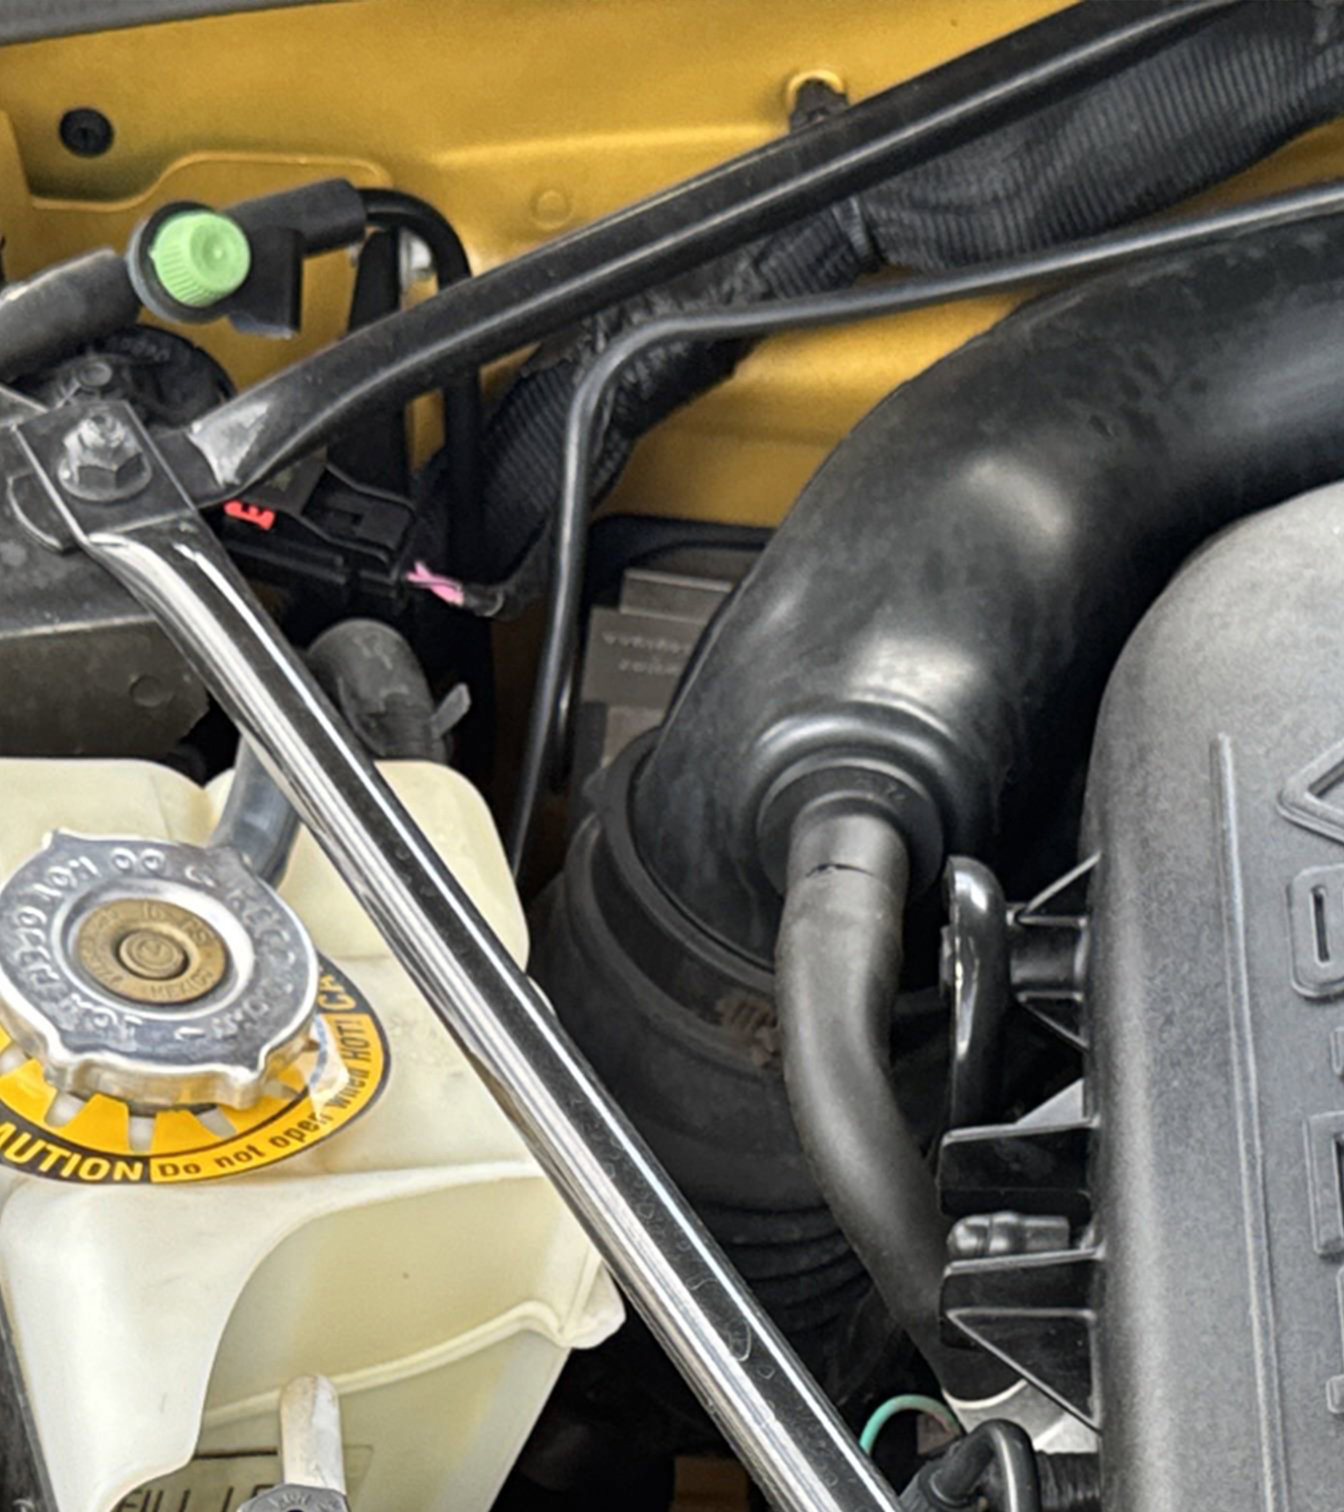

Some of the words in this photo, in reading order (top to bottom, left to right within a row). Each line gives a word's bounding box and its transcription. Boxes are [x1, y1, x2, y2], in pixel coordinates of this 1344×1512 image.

[157, 1161, 202, 1178] Do
[214, 1143, 266, 1169] not
[268, 1112, 331, 1150] open
[334, 1018, 372, 1063] HOT!
